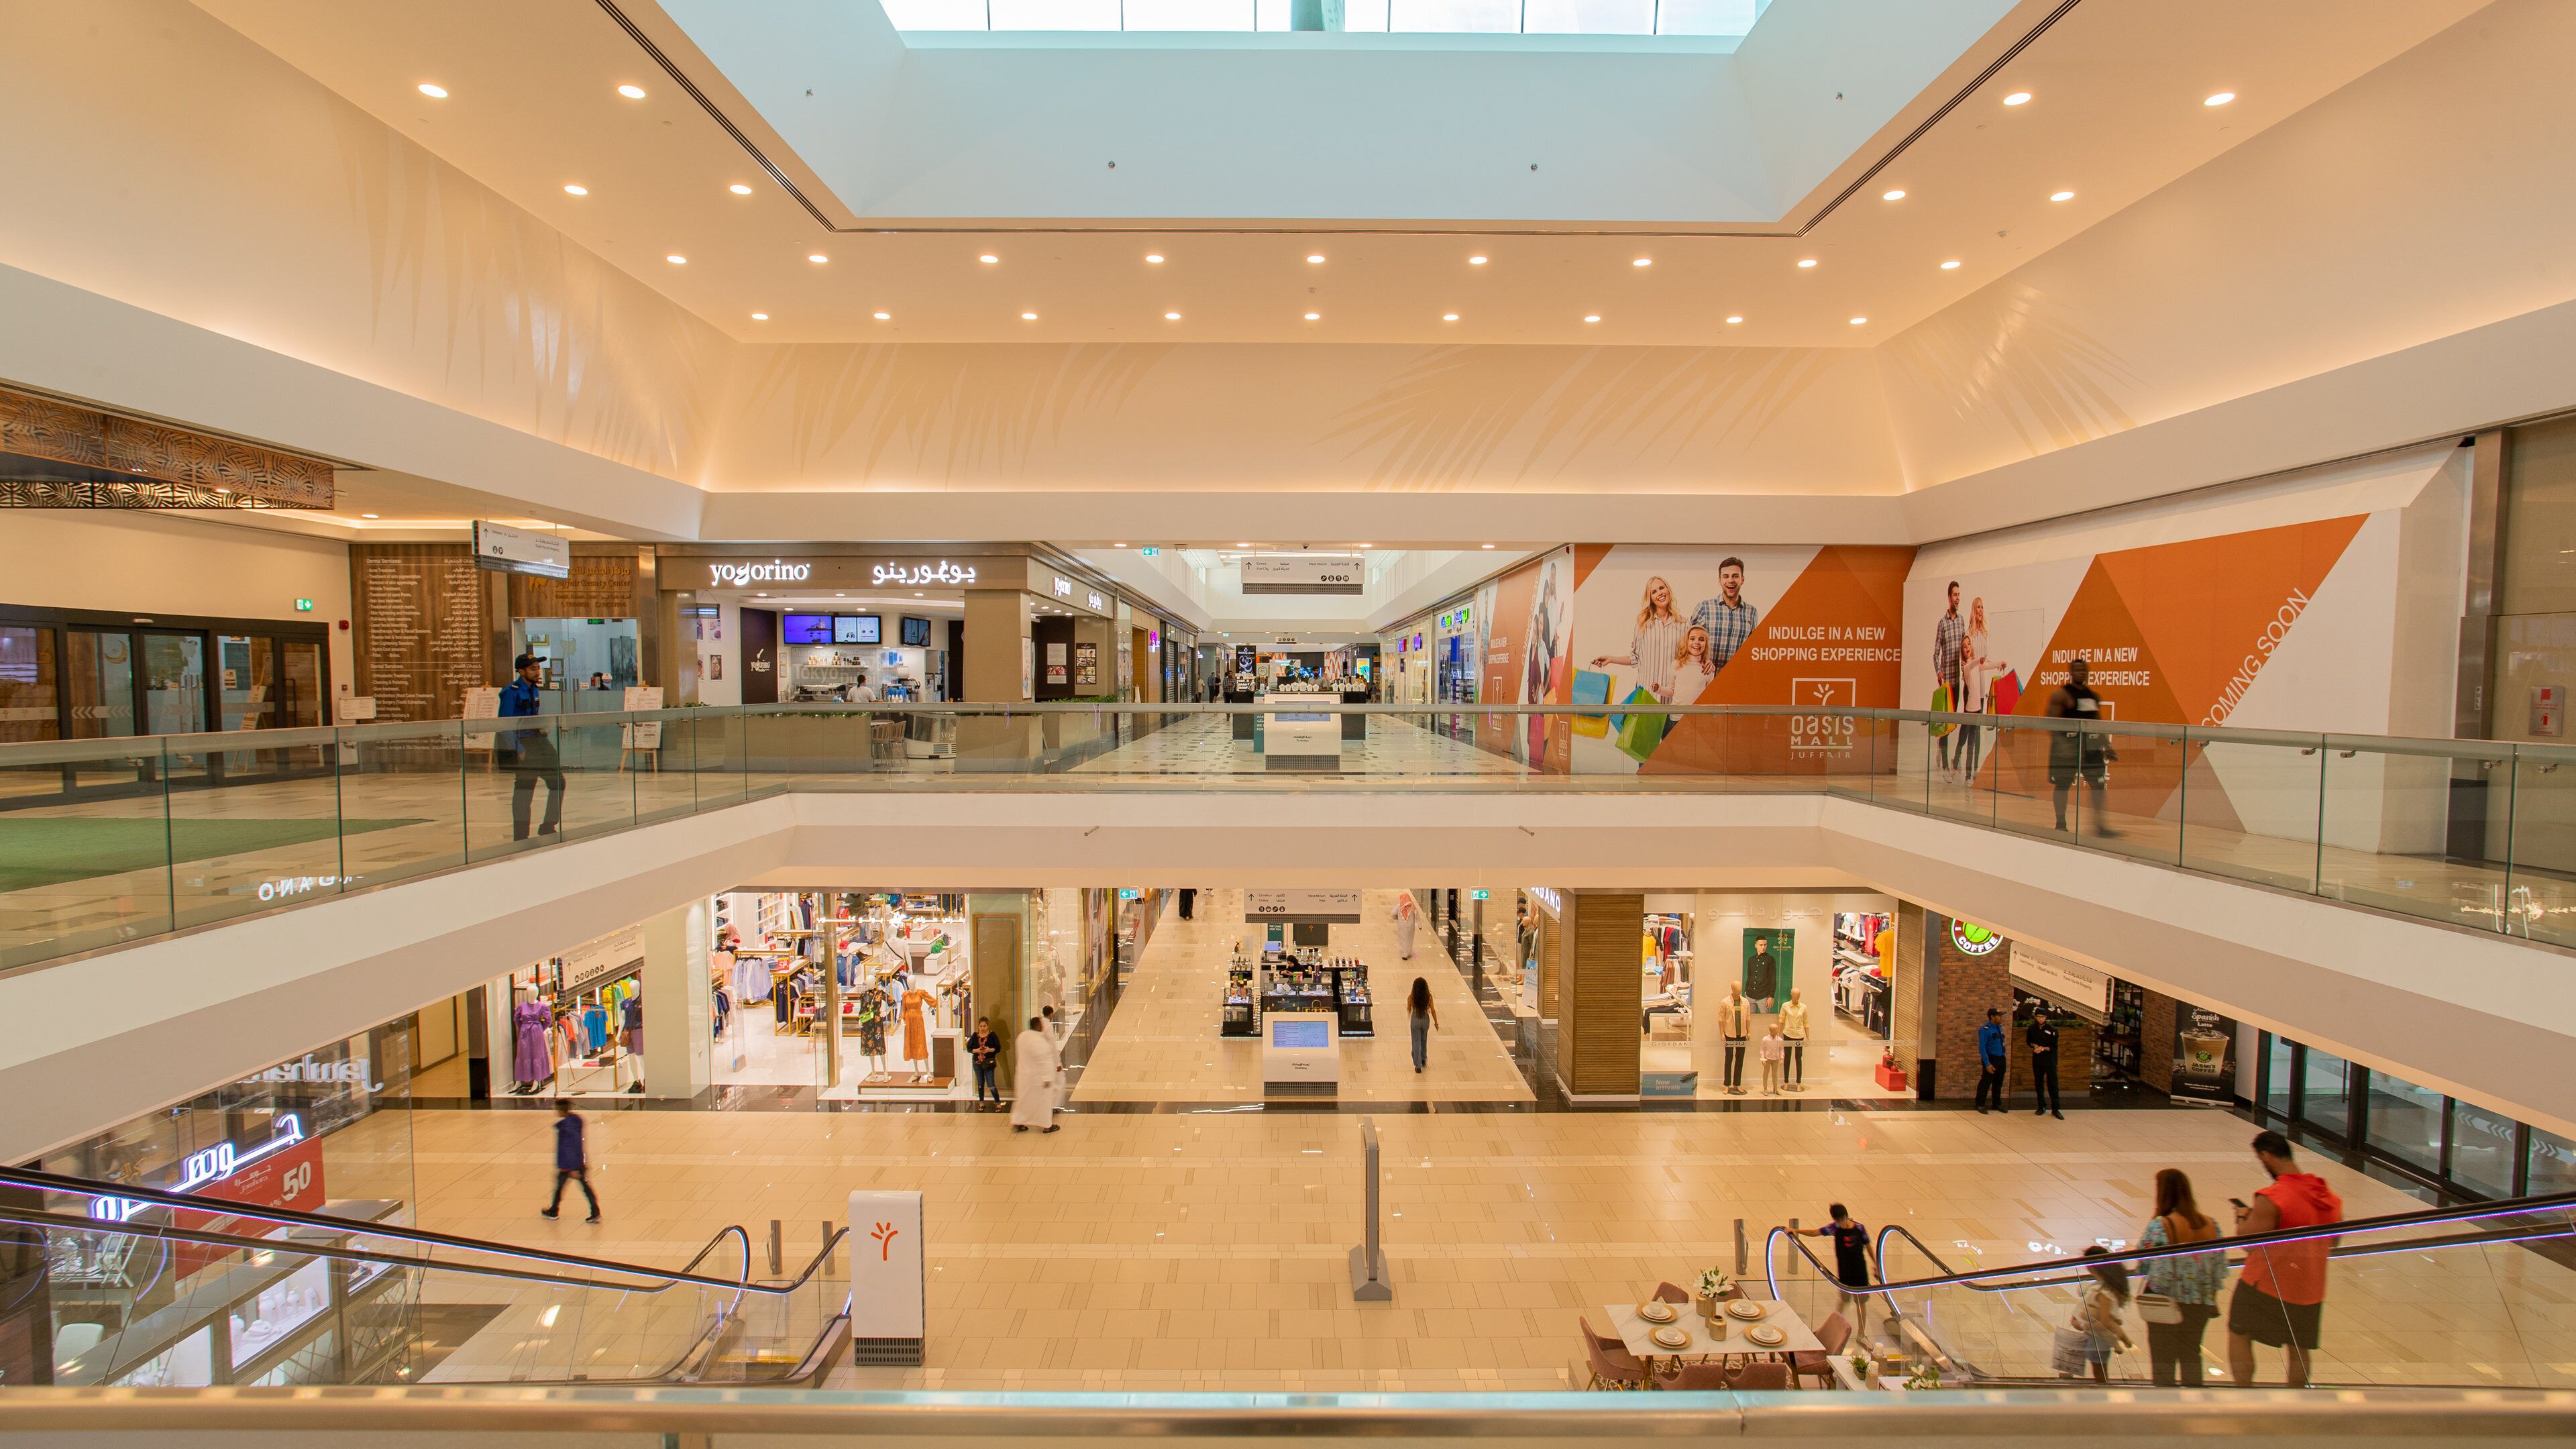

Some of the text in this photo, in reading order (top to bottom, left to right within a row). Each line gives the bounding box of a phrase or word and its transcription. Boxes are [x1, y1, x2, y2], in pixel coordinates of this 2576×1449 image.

[710, 559, 809, 586] yogorino
[872, 559, 976, 585] يوغورينو
[581, 580, 606, 589] Beauty
[607, 579, 631, 588] Center
[1768, 626, 1886, 641] INDULGE IN A NEW
[1751, 647, 1901, 661] SHOPPING EXPERIENCE
[2052, 647, 2138, 663] INDULGE IN A NEW
[2201, 587, 2310, 727] COMING SOON
[792, 663, 839, 683] Tokyo
[2088, 671, 2150, 686] EXPERIENCE
[1790, 736, 1854, 745] MALL
[1790, 751, 1851, 760] JUFFAIR
[1958, 936, 1998, 953] COFFEE
[2191, 1012, 2220, 1022] Spanish
[281, 1161, 311, 1201] 50
